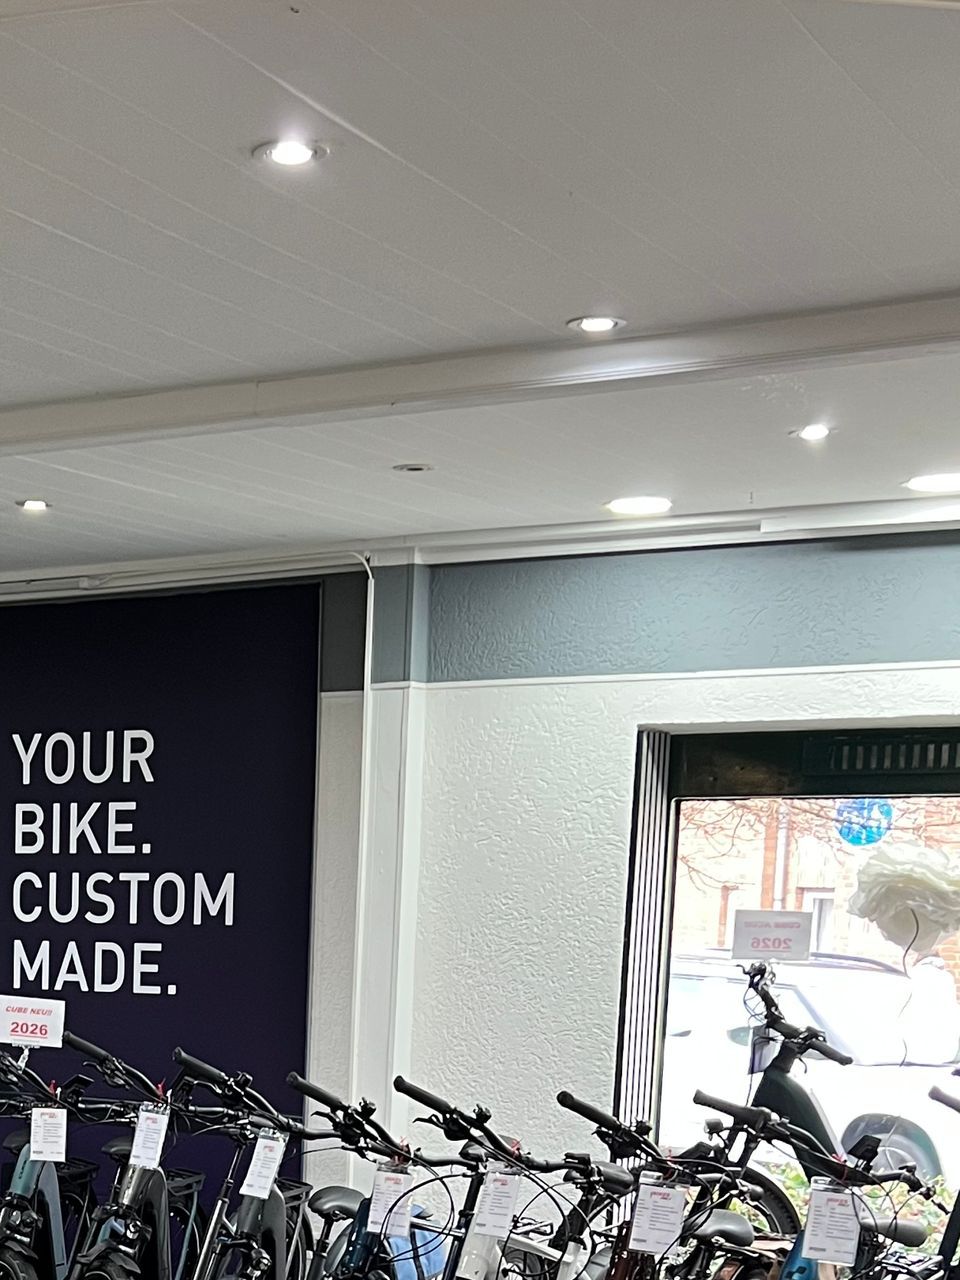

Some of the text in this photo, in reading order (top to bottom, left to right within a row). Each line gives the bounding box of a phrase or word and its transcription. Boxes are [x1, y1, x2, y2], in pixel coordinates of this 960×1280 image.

[12, 729, 155, 785] YOUR
[15, 802, 151, 854] BIKE.
[12, 872, 235, 926] CUSTOM
[12, 939, 177, 994] MADE.
[10, 1021, 48, 1036] 2026
